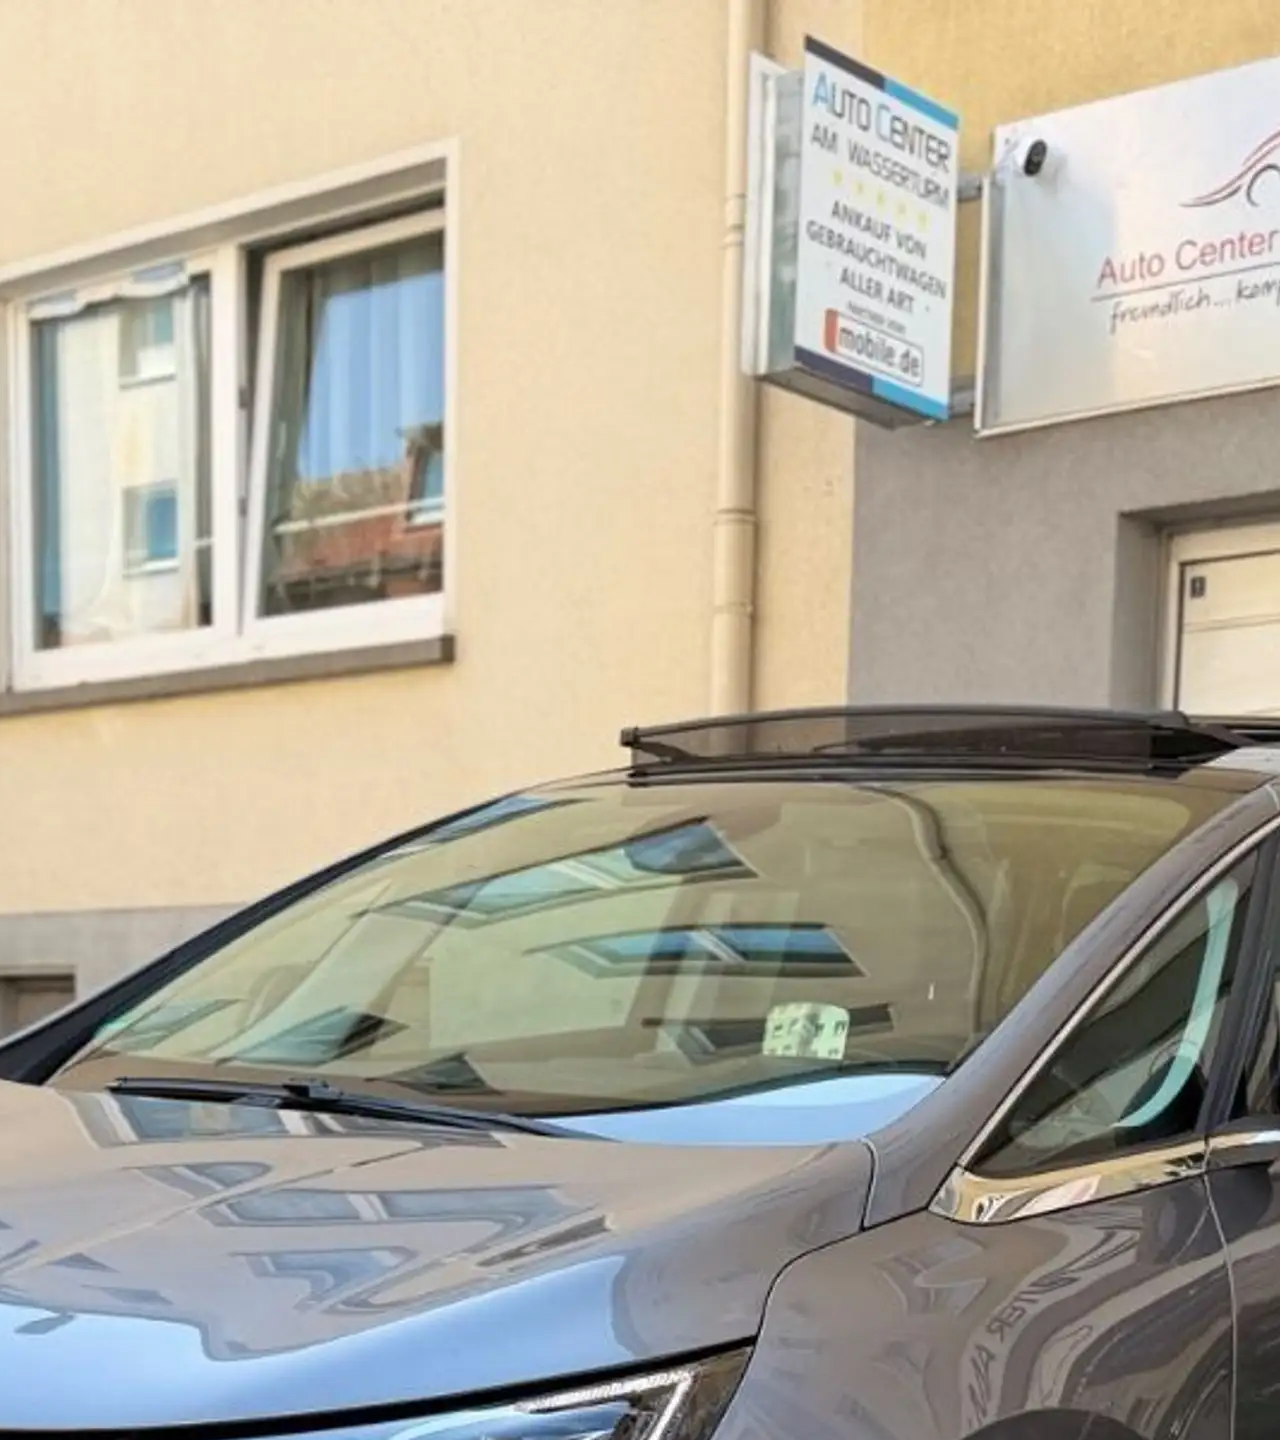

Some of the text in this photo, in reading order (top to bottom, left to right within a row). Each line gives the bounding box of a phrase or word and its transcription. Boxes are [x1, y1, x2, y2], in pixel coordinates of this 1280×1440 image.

[813, 72, 951, 173] AUTO CENTER
[812, 123, 950, 209] AM WASSERTURM
[806, 219, 947, 300] GEBRAUCHTWAGEN
[831, 200, 927, 262] ANKAUF VON
[1097, 253, 1165, 290] Auto
[1175, 228, 1280, 271] Center
[839, 266, 915, 315] ALLER ART
